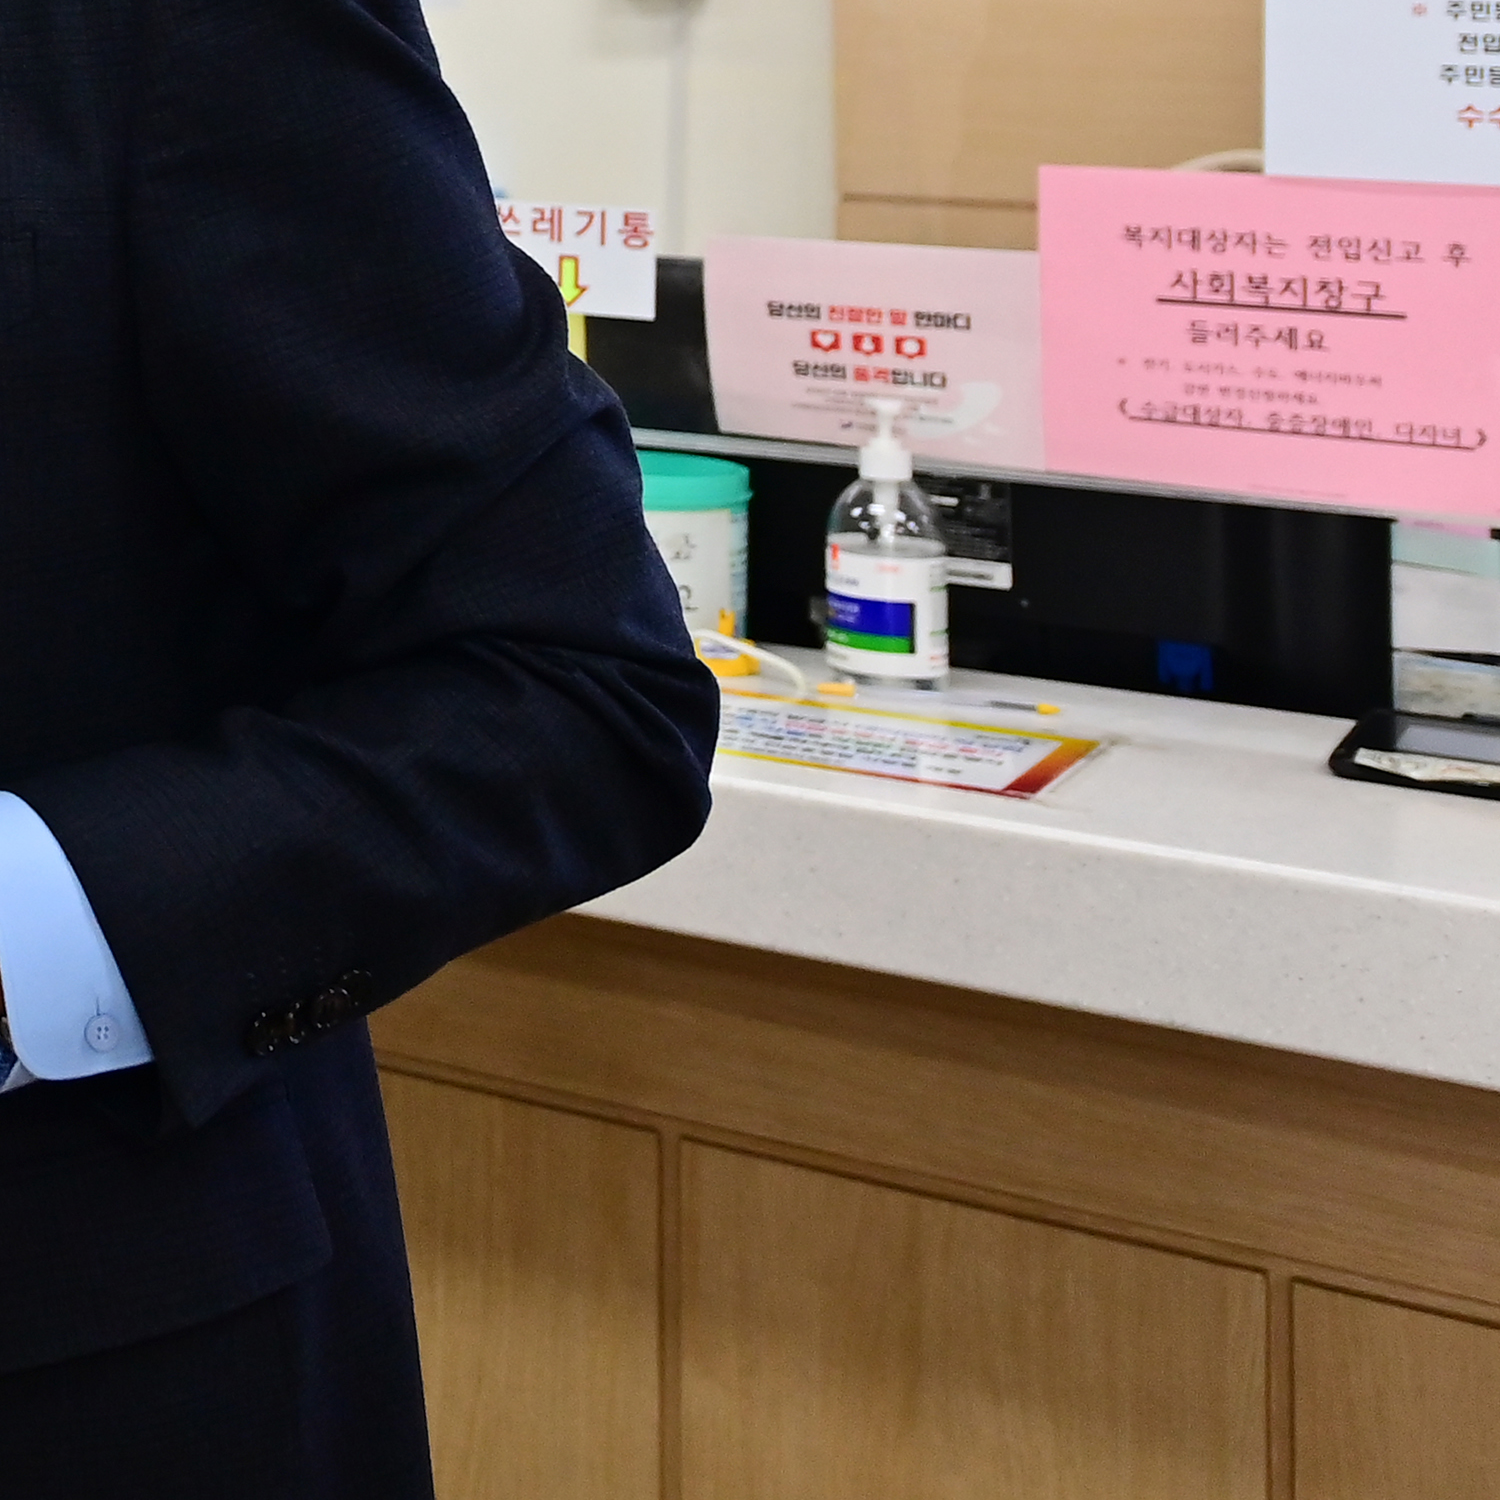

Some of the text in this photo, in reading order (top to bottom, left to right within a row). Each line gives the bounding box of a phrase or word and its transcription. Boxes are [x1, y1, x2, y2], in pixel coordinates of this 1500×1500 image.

[1124, 224, 1472, 268] 복지대상자는 전입신고 후
[1170, 269, 1386, 313] 사회복지창구
[766, 300, 822, 320] 당신의
[1187, 319, 1330, 352] 들러주세요
[792, 360, 847, 380] 당신의
